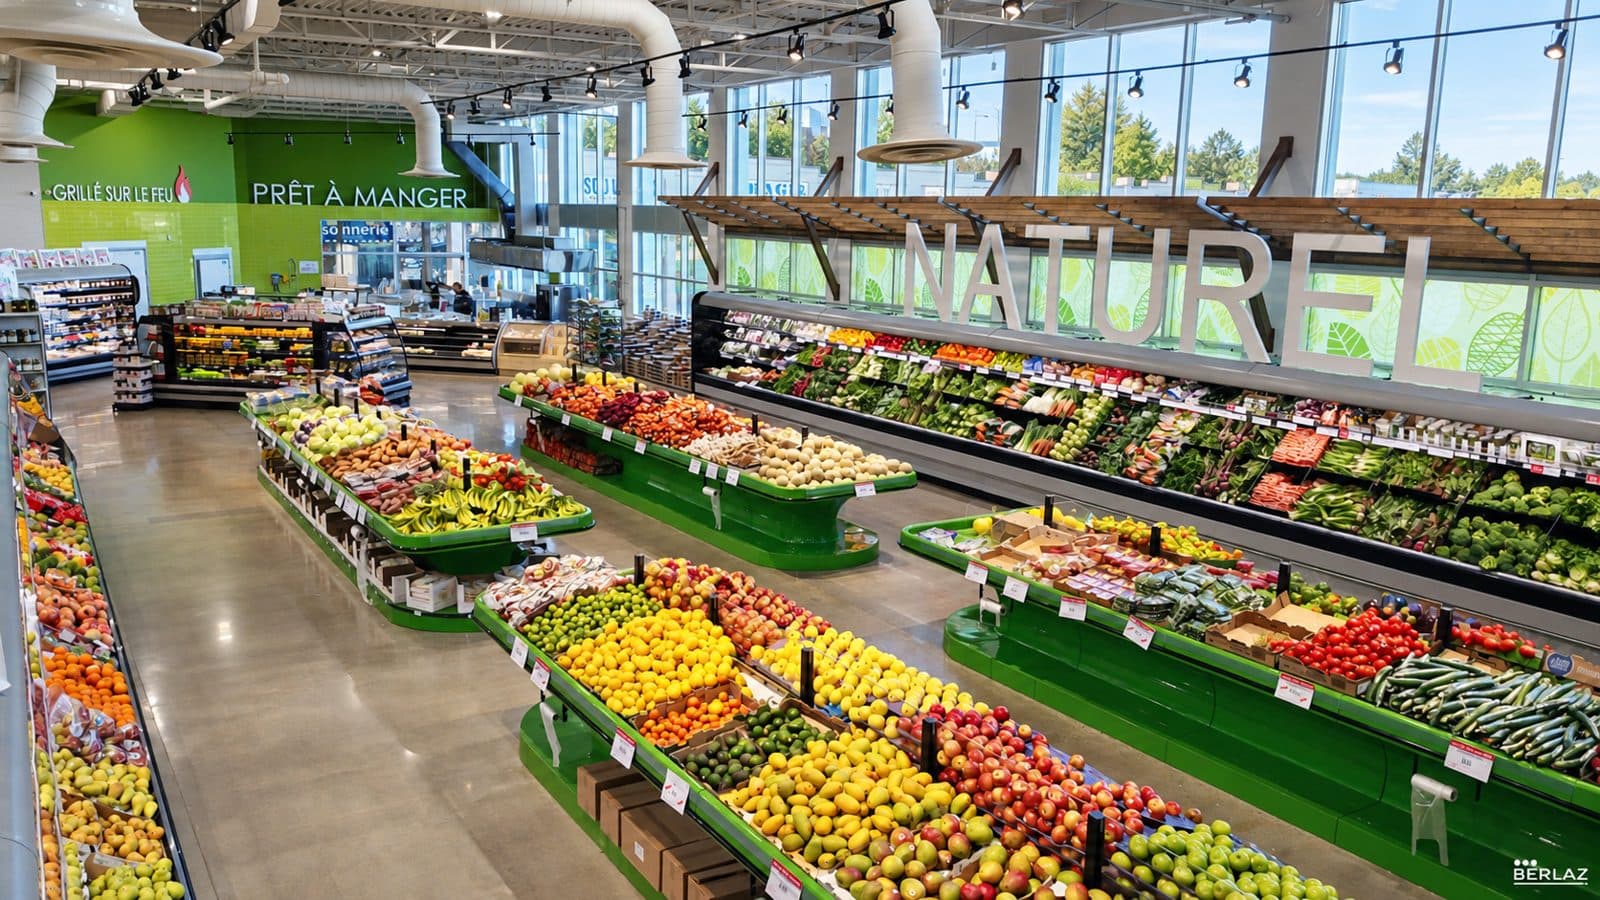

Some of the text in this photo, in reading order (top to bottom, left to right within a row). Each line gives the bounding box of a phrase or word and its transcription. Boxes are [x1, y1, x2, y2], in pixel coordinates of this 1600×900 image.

[52, 181, 173, 203] GRILLÉ SUR LE FEU
[253, 180, 467, 208] PRÊT À MANGER
[903, 222, 1481, 391] NATUREL
